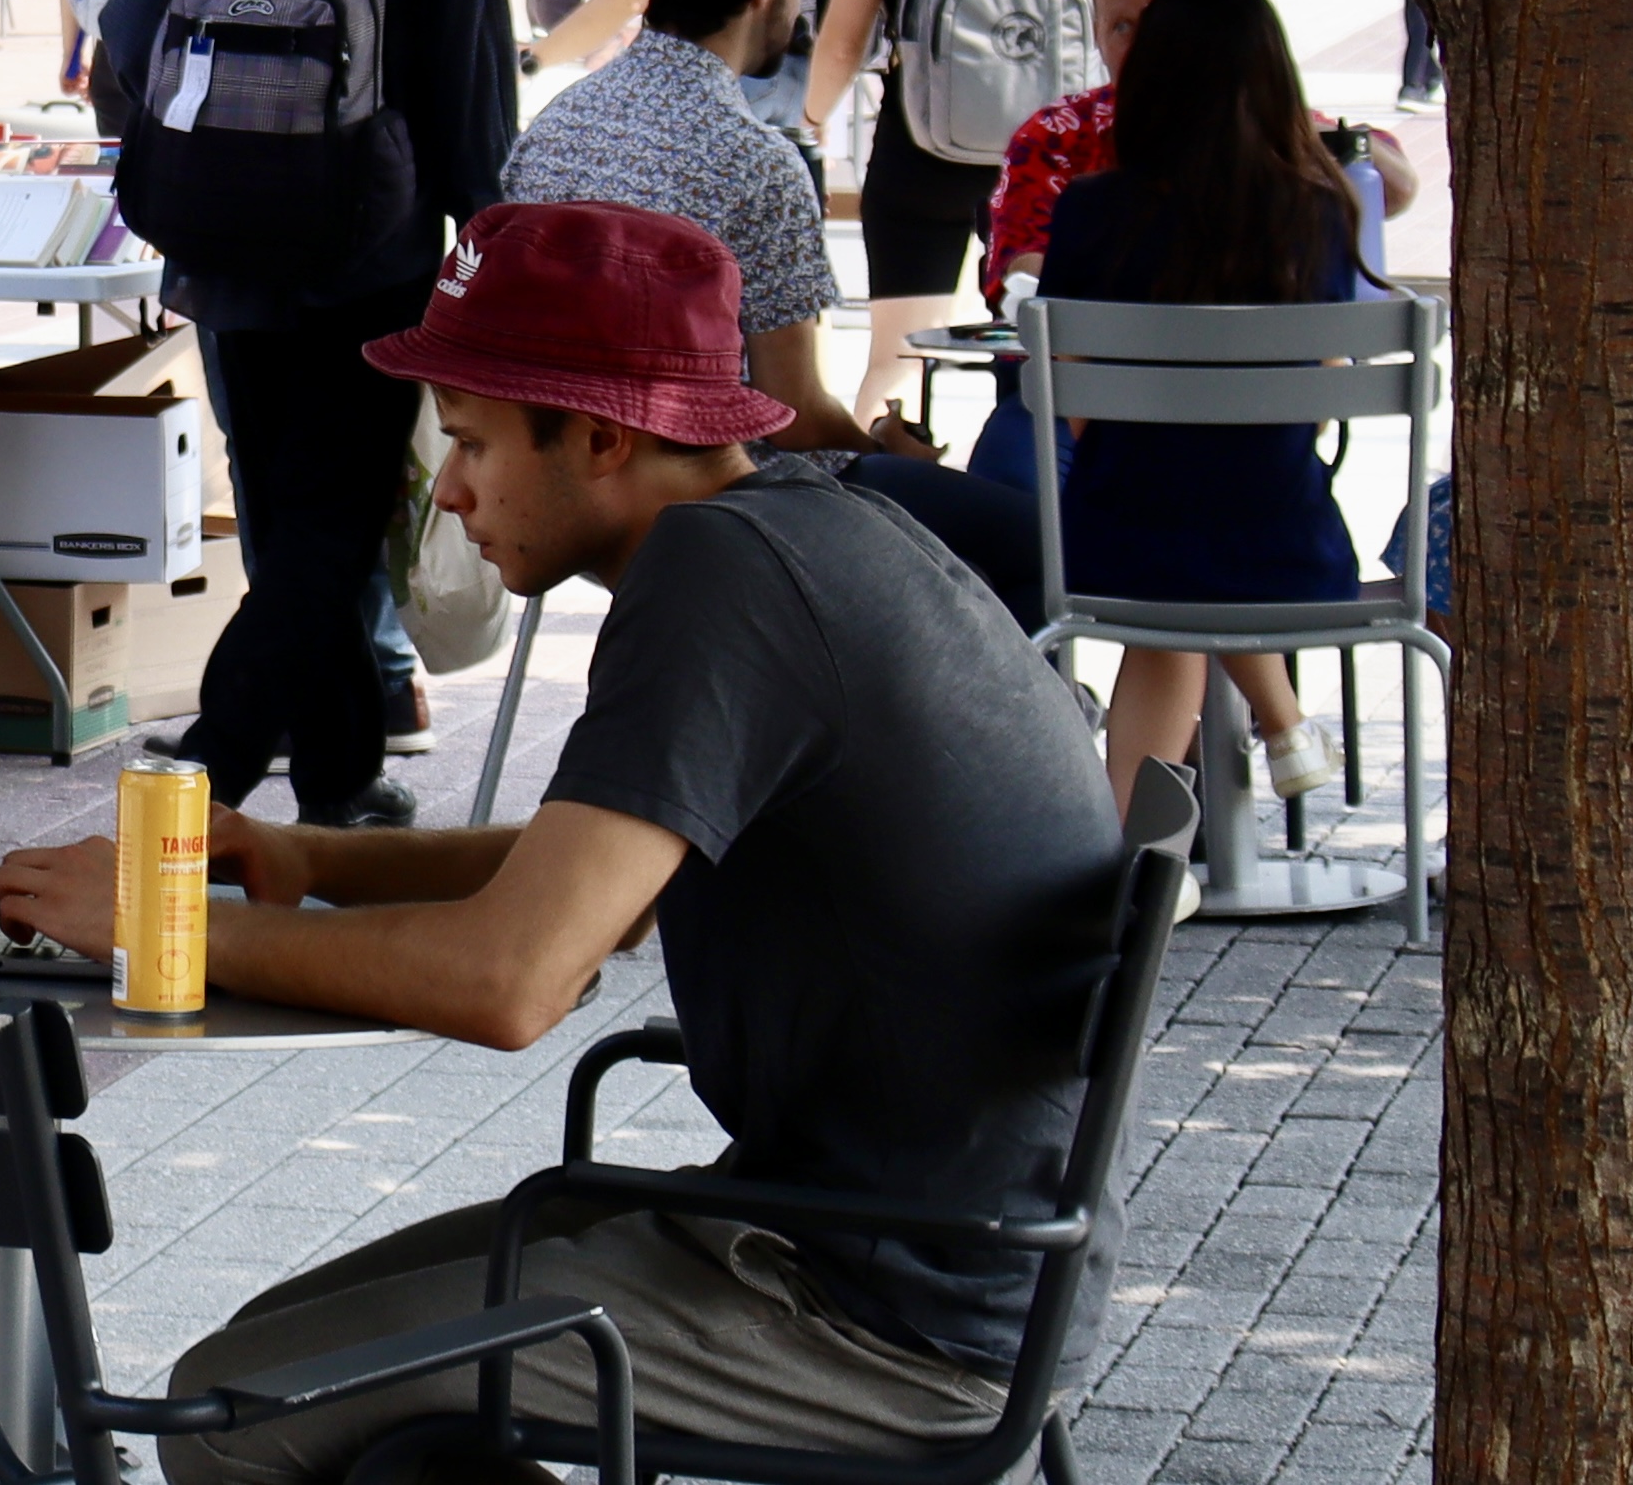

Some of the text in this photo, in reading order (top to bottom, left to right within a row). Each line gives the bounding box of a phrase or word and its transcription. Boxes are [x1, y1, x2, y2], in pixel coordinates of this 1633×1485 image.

[437, 278, 468, 299] adidas
[59, 540, 142, 551] BANKERS BOX
